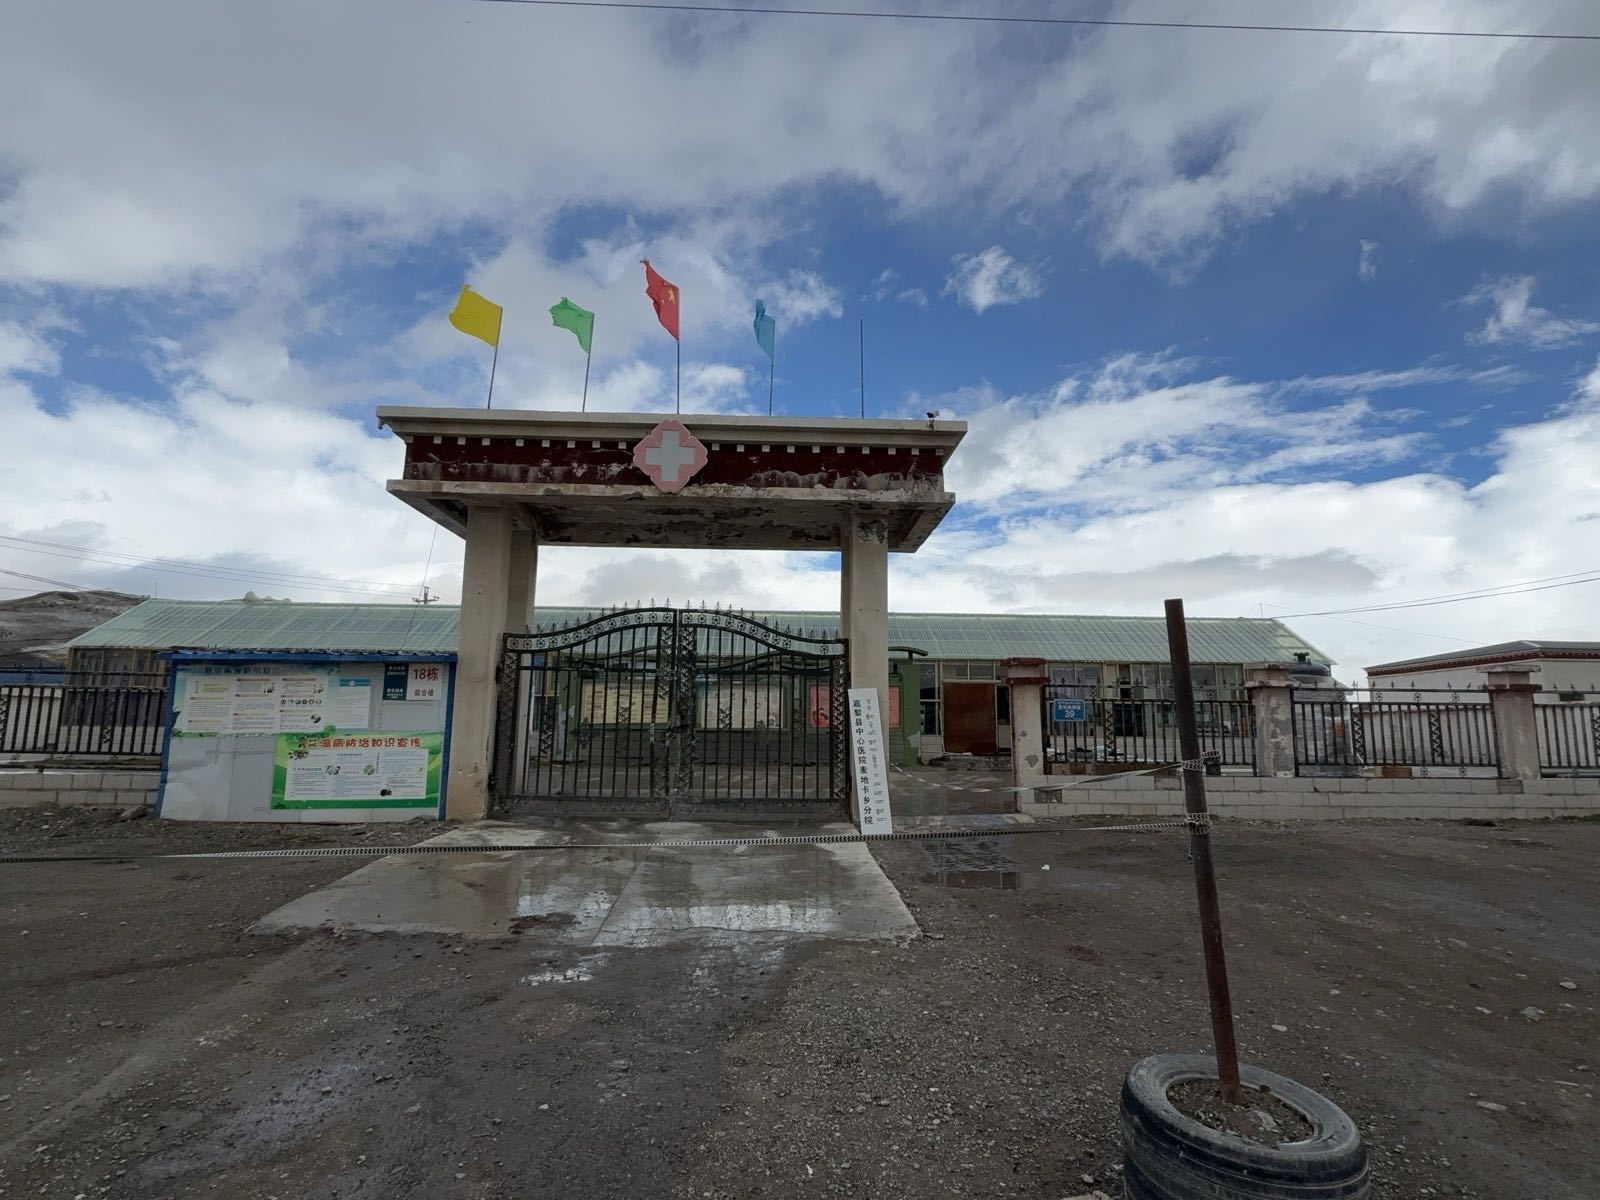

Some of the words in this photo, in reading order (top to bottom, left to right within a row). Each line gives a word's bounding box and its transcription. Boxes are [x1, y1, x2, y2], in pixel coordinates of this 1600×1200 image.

[413, 666, 439, 681] 18栋
[414, 688, 435, 697] 综合楼
[1064, 709, 1076, 719] 39
[852, 698, 875, 826] 嘉黎县中心医院麦地卡乡分院
